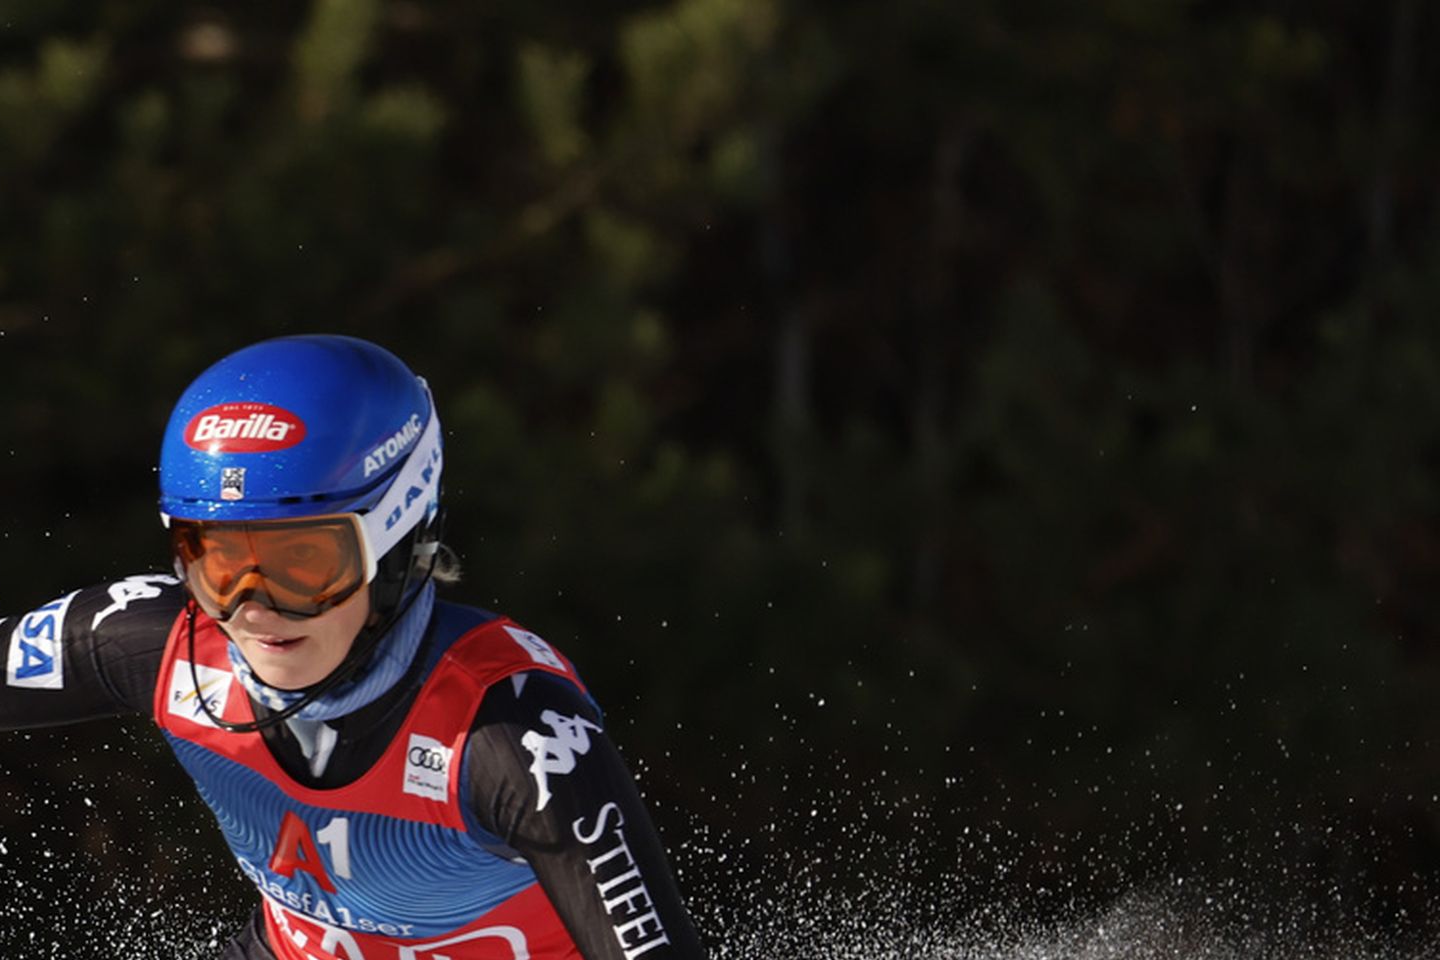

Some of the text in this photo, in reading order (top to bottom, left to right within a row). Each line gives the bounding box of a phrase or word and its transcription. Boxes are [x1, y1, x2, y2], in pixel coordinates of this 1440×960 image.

[192, 413, 289, 442] Barilla
[363, 413, 423, 479] ATOMIC
[384, 430, 442, 531] OAKL
[269, 811, 351, 895] A1
